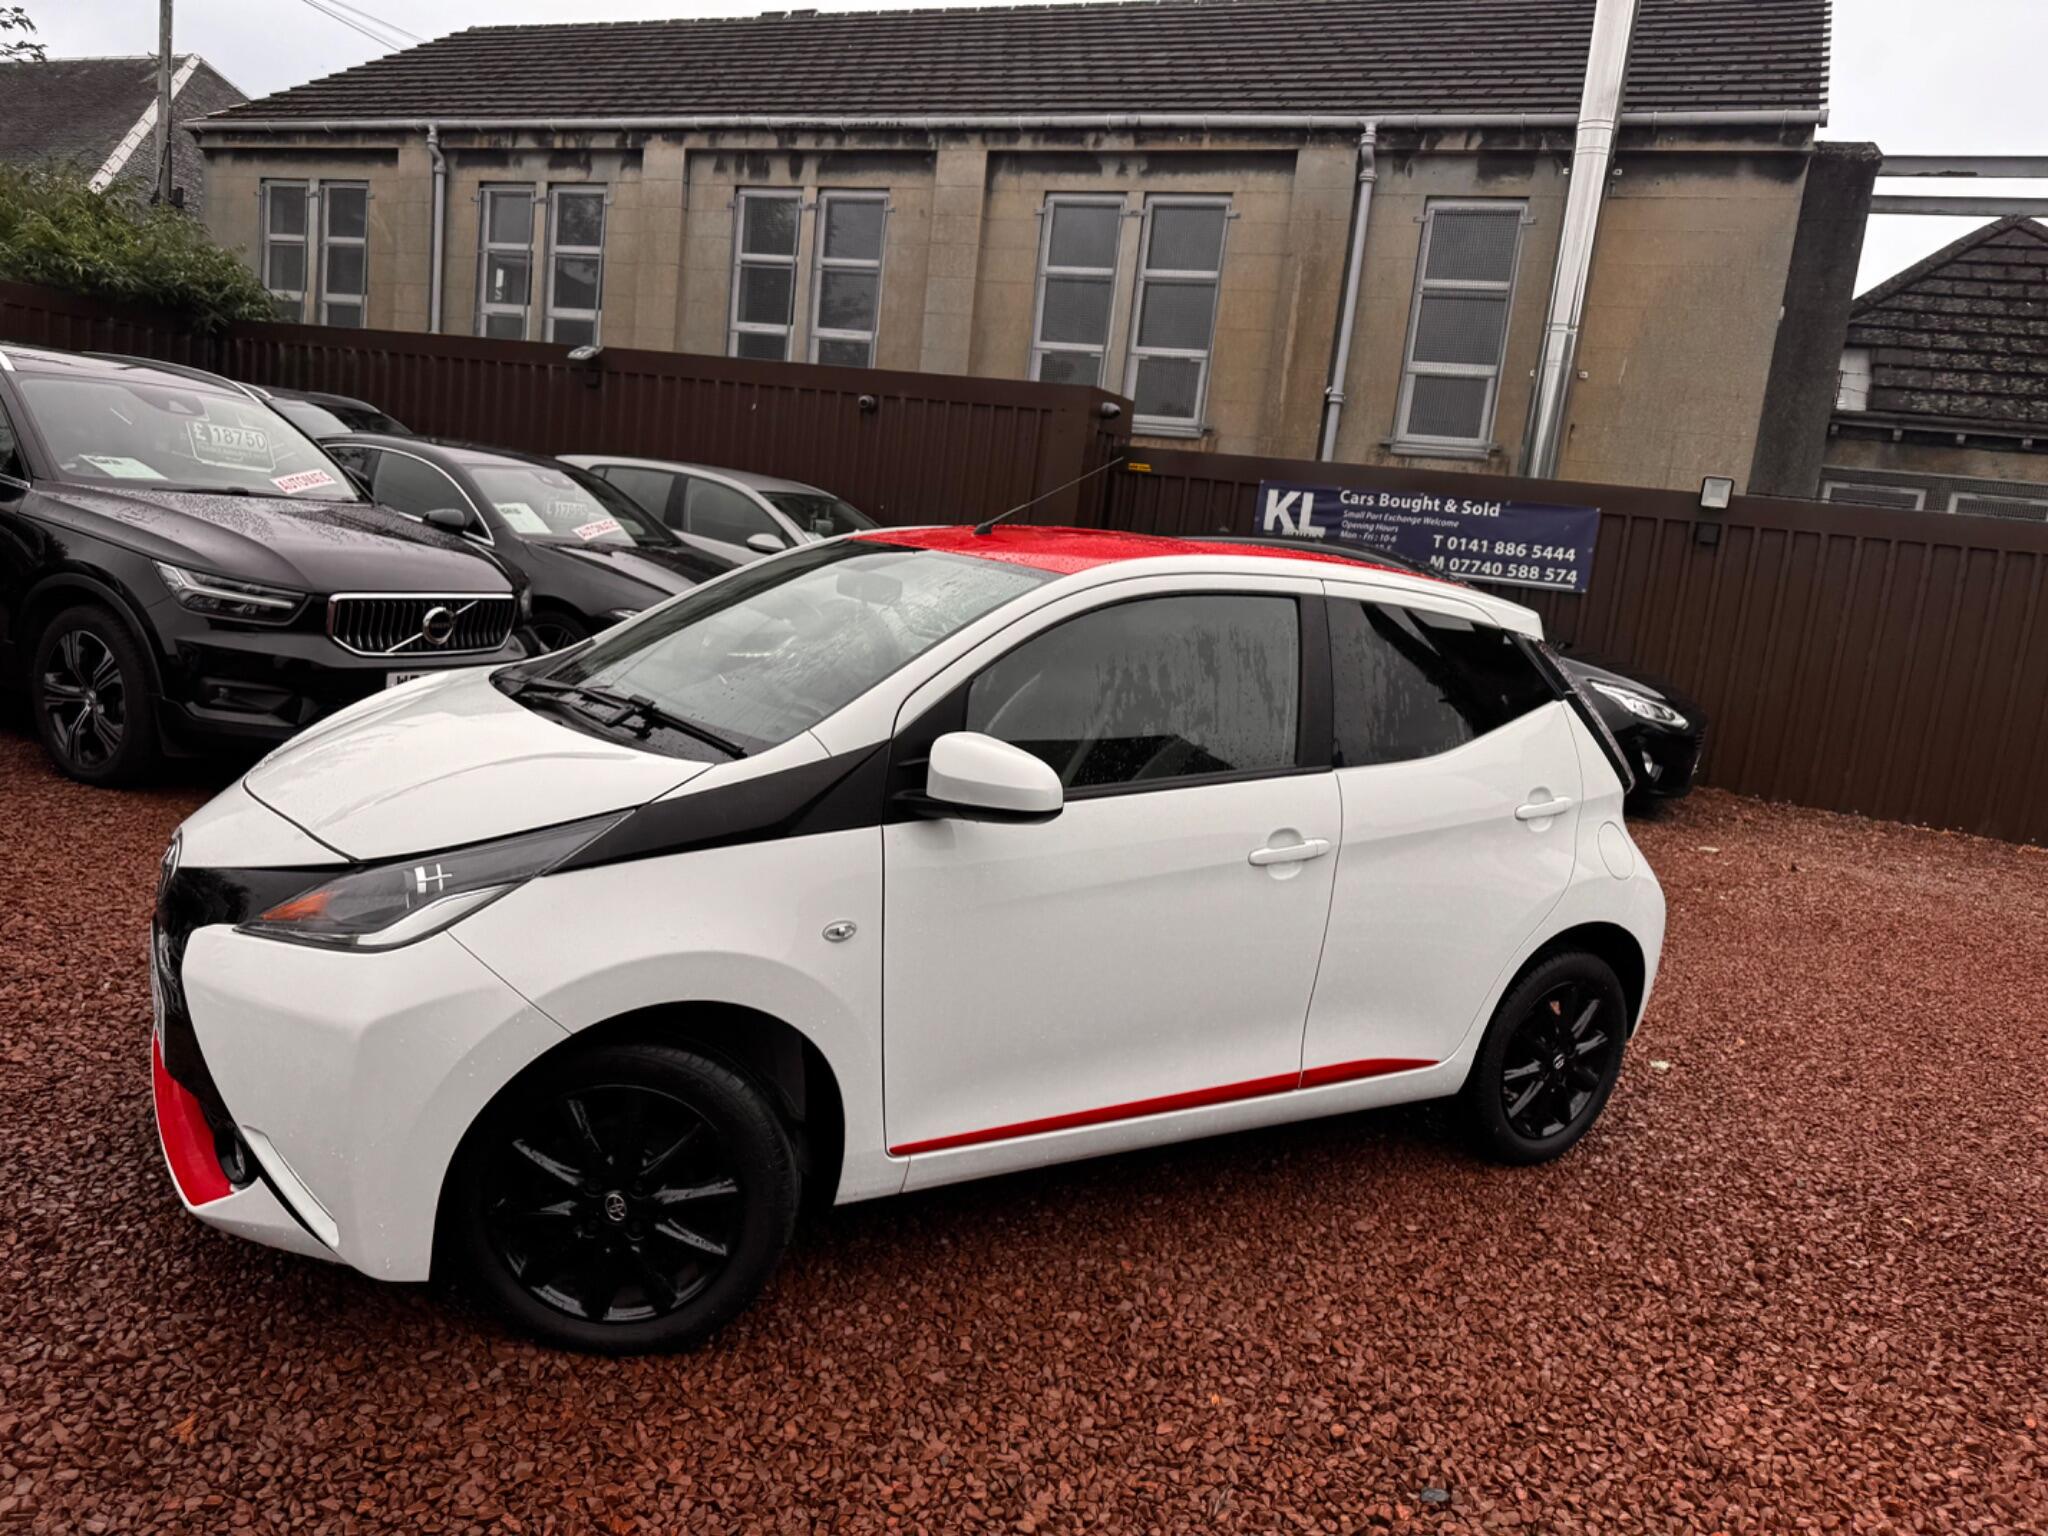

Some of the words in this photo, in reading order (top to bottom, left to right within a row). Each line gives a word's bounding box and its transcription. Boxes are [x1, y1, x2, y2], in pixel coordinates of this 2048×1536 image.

[1263, 488, 1326, 537] KL
[1340, 490, 1375, 506] Cars
[1379, 493, 1441, 513] Bought
[1444, 499, 1458, 513] &
[1461, 500, 1501, 517] Sold
[1341, 520, 1374, 532] Opening
[1343, 510, 1365, 520] Small
[1383, 512, 1422, 526] Exchange
[1423, 517, 1459, 528] Welcome
[1433, 535, 1443, 548] T
[1447, 536, 1488, 553] 0141
[1494, 541, 1527, 557] 886
[1531, 545, 1576, 562] 5444
[1430, 555, 1445, 570] M
[1449, 558, 1503, 576] 07740
[1507, 563, 1540, 579] 588
[1544, 568, 1577, 583] 574
